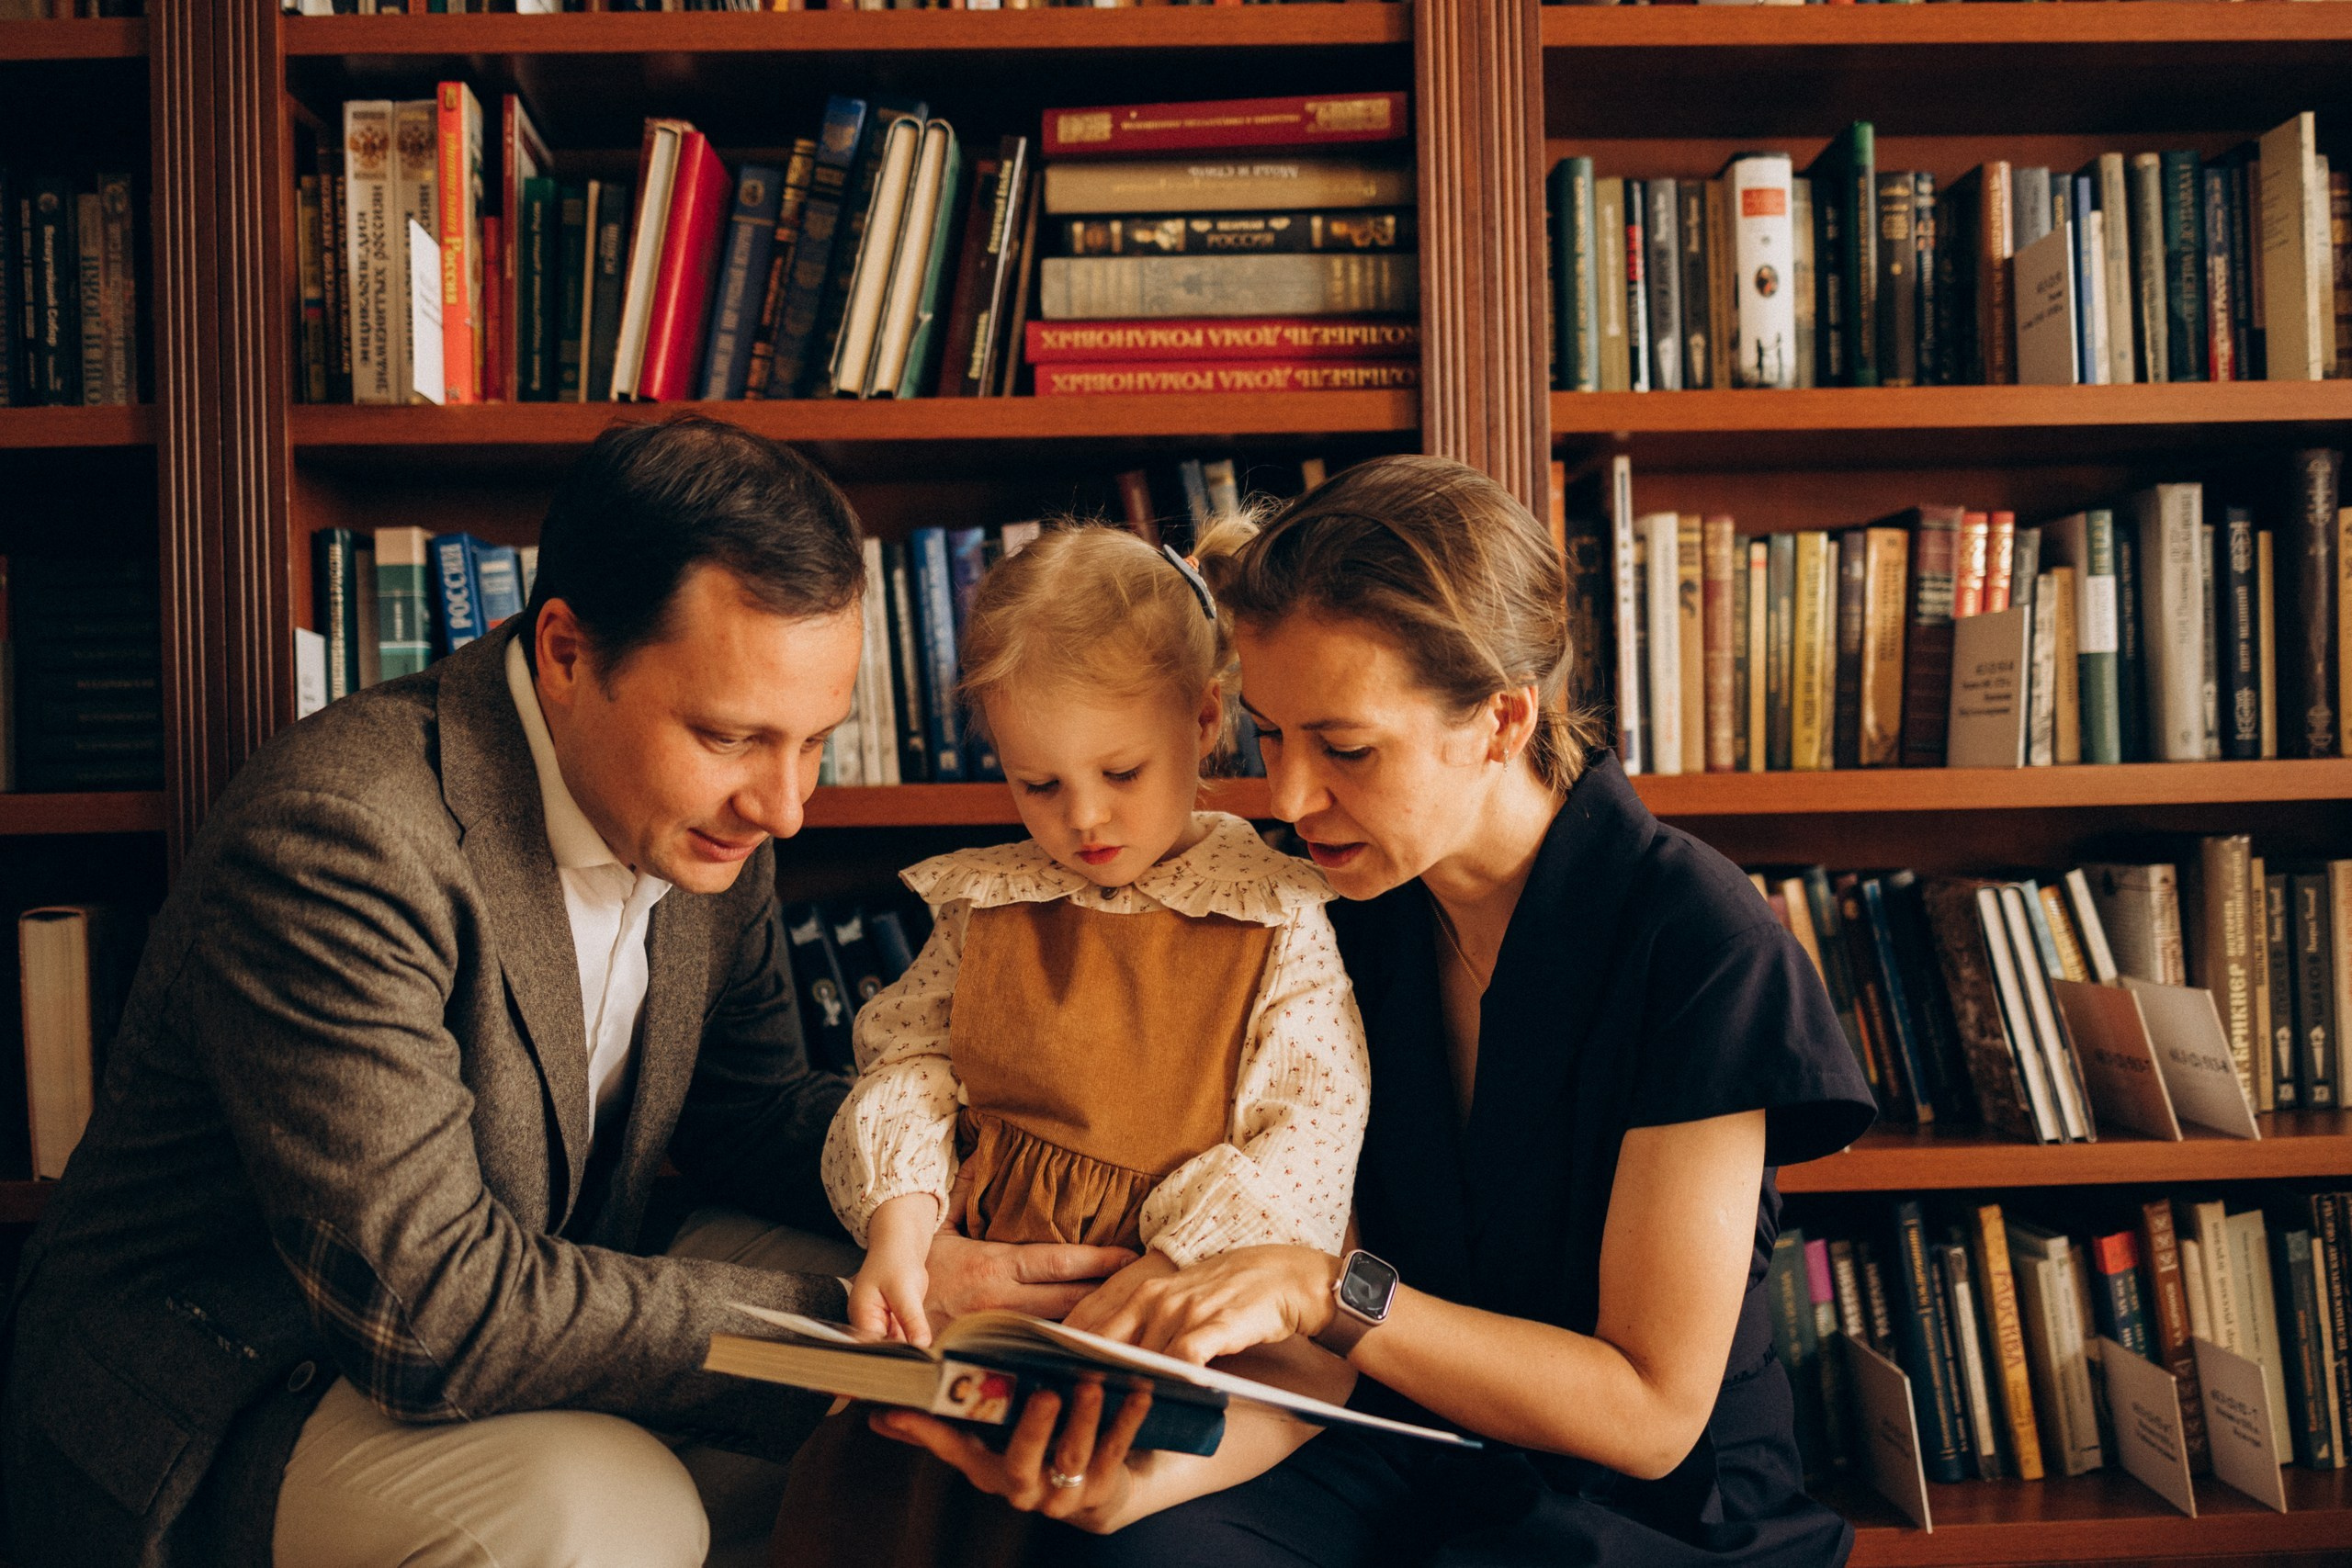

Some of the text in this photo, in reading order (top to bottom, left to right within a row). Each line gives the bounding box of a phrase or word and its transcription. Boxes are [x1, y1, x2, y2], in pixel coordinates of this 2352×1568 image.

[357, 211, 370, 366] ЭНЦИКЛОПЕДИЯ
[371, 185, 388, 393] ЗНАМЕНИТЫХ РОССИЯН
[445, 236, 459, 305] Россия
[1041, 330, 1204, 350] РОМАНОВЫХ
[1206, 327, 1283, 351] ДОМА
[1051, 371, 1214, 392] РОМАНОВЫХ
[1216, 369, 1292, 391] ДОМА
[438, 543, 473, 628] РОССИИ
[1994, 1269, 2023, 1369] МОСКВА
